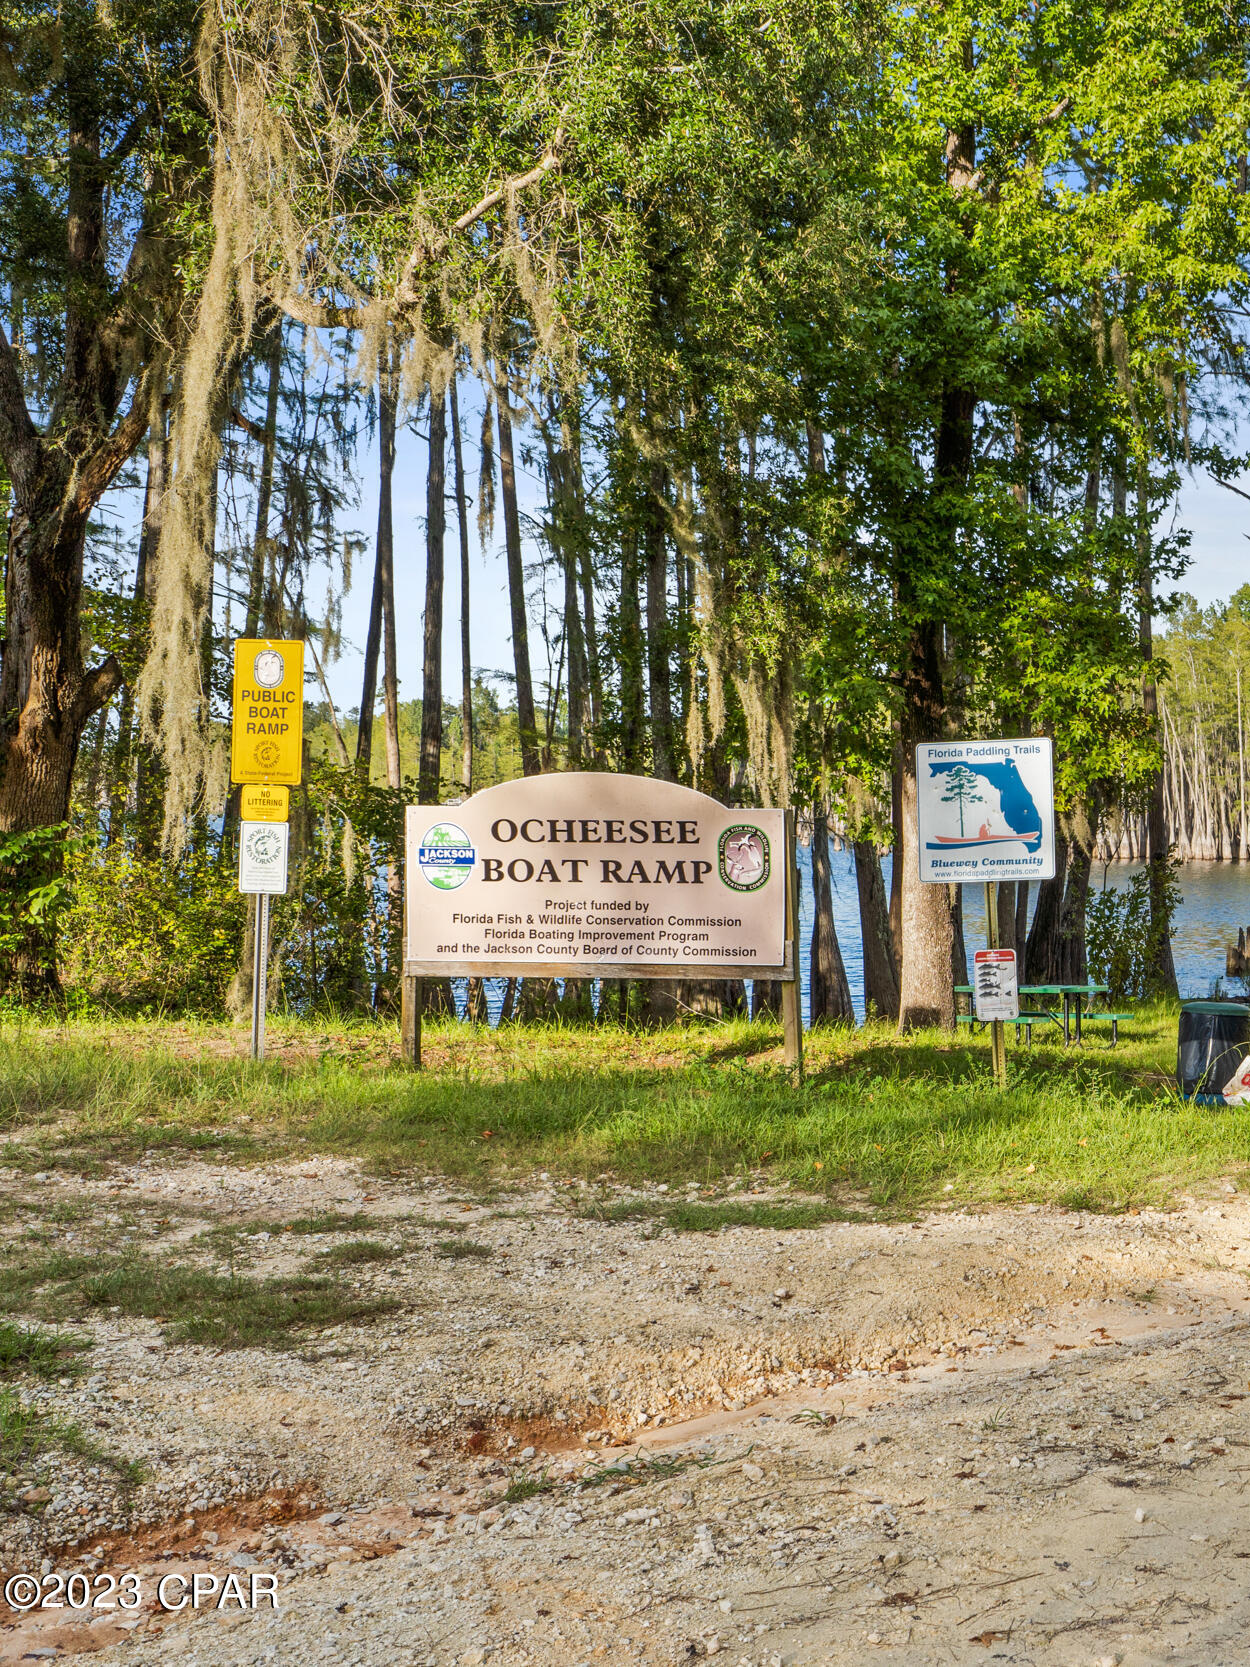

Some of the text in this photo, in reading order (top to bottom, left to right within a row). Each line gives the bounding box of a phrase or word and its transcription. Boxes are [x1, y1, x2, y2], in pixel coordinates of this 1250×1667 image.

[241, 690, 296, 703] PUBLIC
[248, 706, 288, 719] BOAT
[246, 722, 289, 735] RAMP
[928, 745, 1041, 758] Florida Paddling Trails
[260, 790, 271, 798] NO
[247, 798, 283, 807] LITTERING
[490, 818, 701, 844] OCHEESEE
[245, 844, 282, 865] RESTORATION
[420, 849, 474, 863] JACKSON
[429, 857, 456, 865] County
[930, 856, 1044, 869] Blueway Community
[481, 858, 713, 884] BOAT RAMP
[719, 861, 770, 890] CONSERVATION COMMISSION
[545, 899, 650, 913] Project funded by
[452, 913, 742, 927] Florida Fish & Wildlife Conservation Commission
[484, 928, 709, 943] Florida Boating Improvement Program
[436, 943, 757, 958] and the Jackson County Board of County Commission
